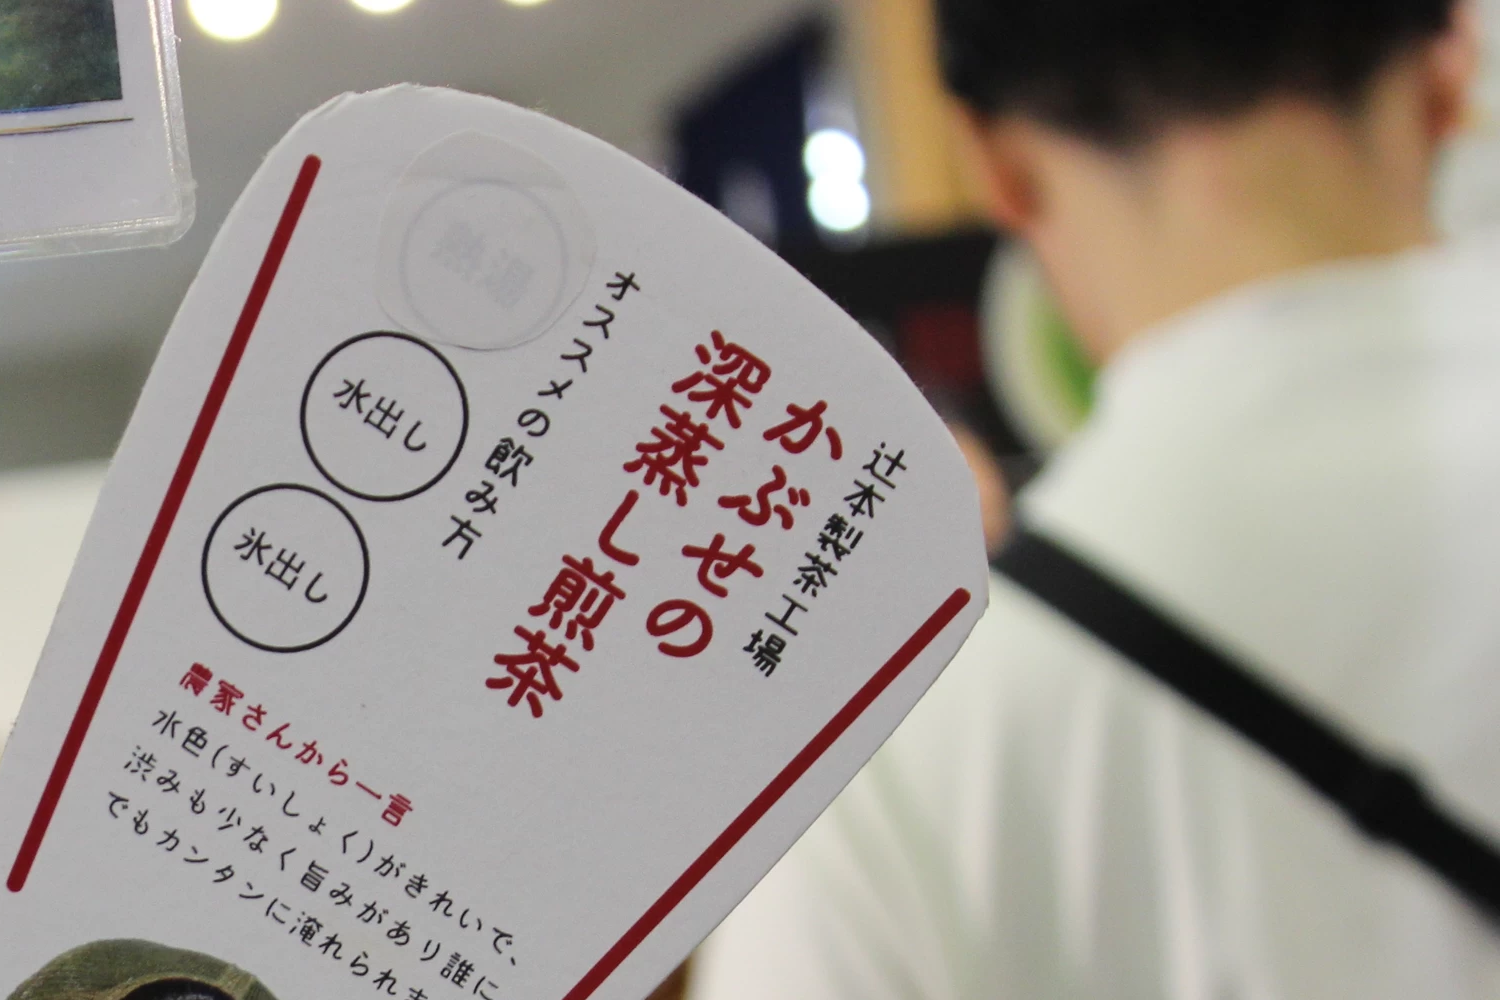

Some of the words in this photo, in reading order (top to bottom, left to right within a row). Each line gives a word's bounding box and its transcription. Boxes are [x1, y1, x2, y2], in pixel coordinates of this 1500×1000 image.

[333, 379, 427, 452] 水出し
[442, 272, 640, 560] オススメの飲み方
[485, 330, 771, 718] 深蒸し煎茶
[645, 400, 844, 658] かぶせの
[233, 527, 328, 603] 氷出し
[743, 442, 907, 677] 辻本製茶工場
[180, 662, 414, 827] 農家さんから一言
